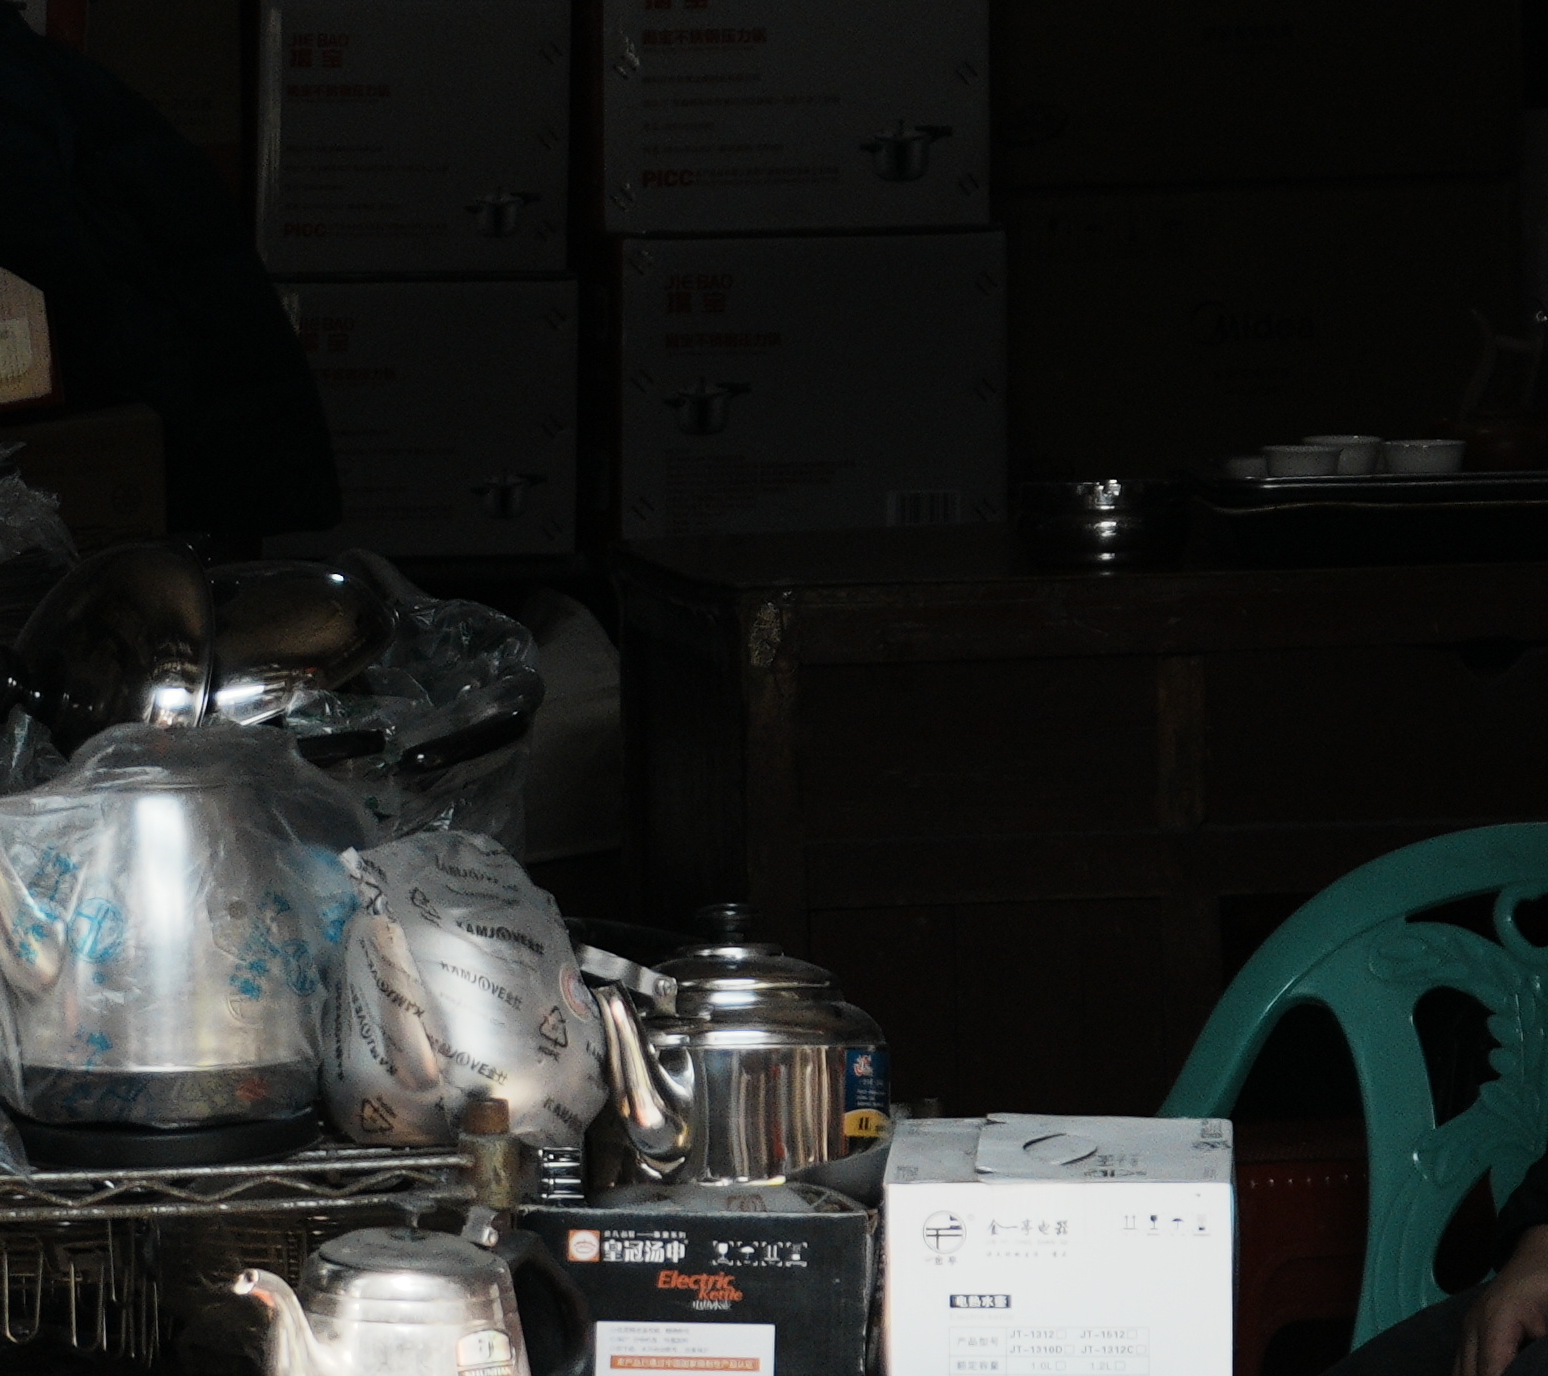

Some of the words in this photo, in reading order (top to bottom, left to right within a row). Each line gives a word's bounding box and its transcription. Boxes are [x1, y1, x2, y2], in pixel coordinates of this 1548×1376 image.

[642, 169, 694, 189] PICC
[657, 1269, 735, 1290] Electric
[698, 1287, 744, 1303] Kettle
